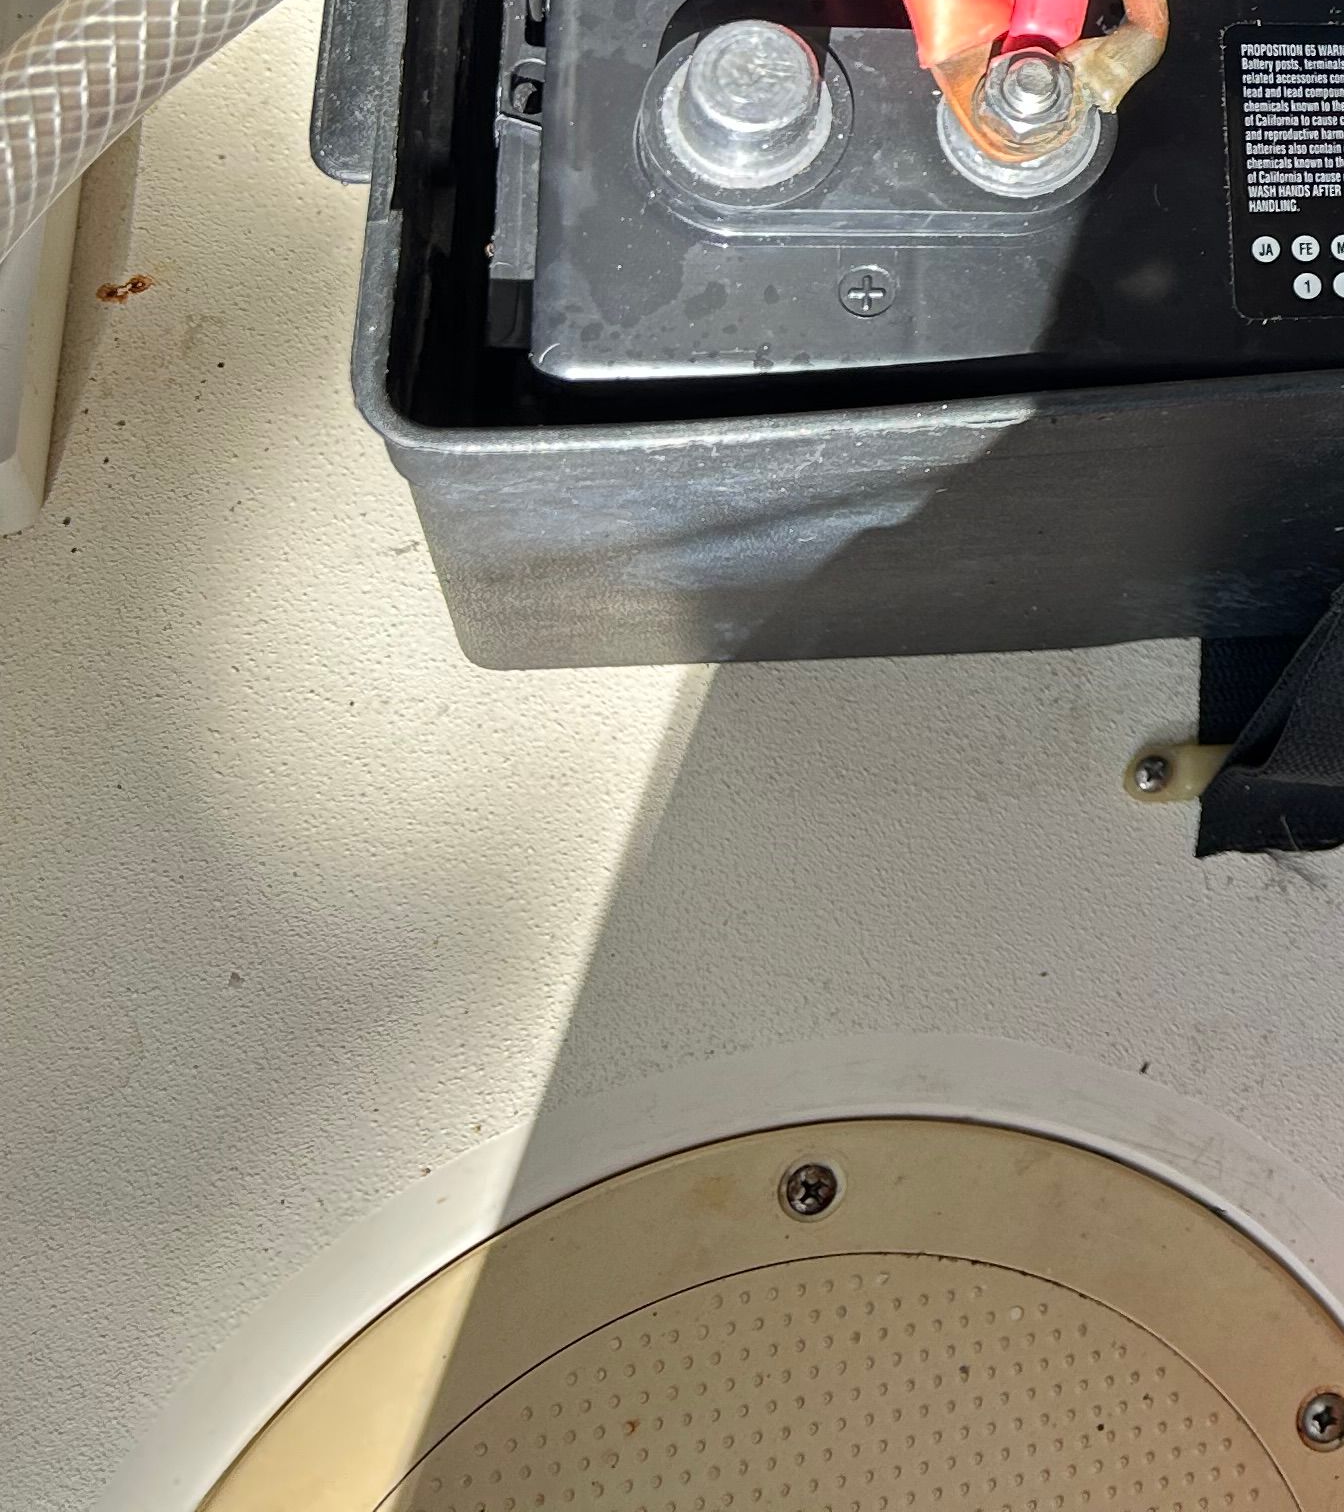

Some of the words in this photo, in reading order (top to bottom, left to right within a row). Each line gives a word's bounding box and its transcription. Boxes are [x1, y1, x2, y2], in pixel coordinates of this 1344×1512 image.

[1241, 44, 1303, 56] PROPOSITION
[1304, 44, 1317, 56] 65
[1241, 58, 1273, 71] Battery
[1275, 59, 1302, 72] posts,
[1242, 72, 1274, 84] related
[1276, 72, 1328, 84] accessories
[1243, 86, 1263, 98] lead
[1265, 86, 1281, 98] and
[1283, 86, 1303, 98] lead
[1244, 100, 1289, 112] chemicals
[1291, 100, 1319, 112] known
[1321, 100, 1330, 112] to
[1245, 114, 1254, 126] of
[1255, 114, 1299, 126] California
[1300, 114, 1310, 126] to
[1312, 114, 1338, 126] cause
[1245, 129, 1262, 140] and
[1264, 129, 1319, 143] reproductive
[1246, 143, 1286, 155] Batteries
[1288, 143, 1307, 155] also
[1309, 143, 1342, 155] contain
[1247, 156, 1292, 168] chemicals
[1294, 156, 1322, 168] known
[1324, 156, 1333, 168] to
[1248, 171, 1257, 183] of
[1258, 171, 1302, 183] California
[1304, 171, 1313, 183] to
[1315, 171, 1341, 183] cause
[1248, 185, 1277, 197] WASH
[1278, 185, 1310, 197] HANDS
[1312, 185, 1342, 197] AFTER
[1248, 199, 1300, 212] HANDLING.
[1259, 244, 1274, 256] JA
[1299, 243, 1313, 255] FE
